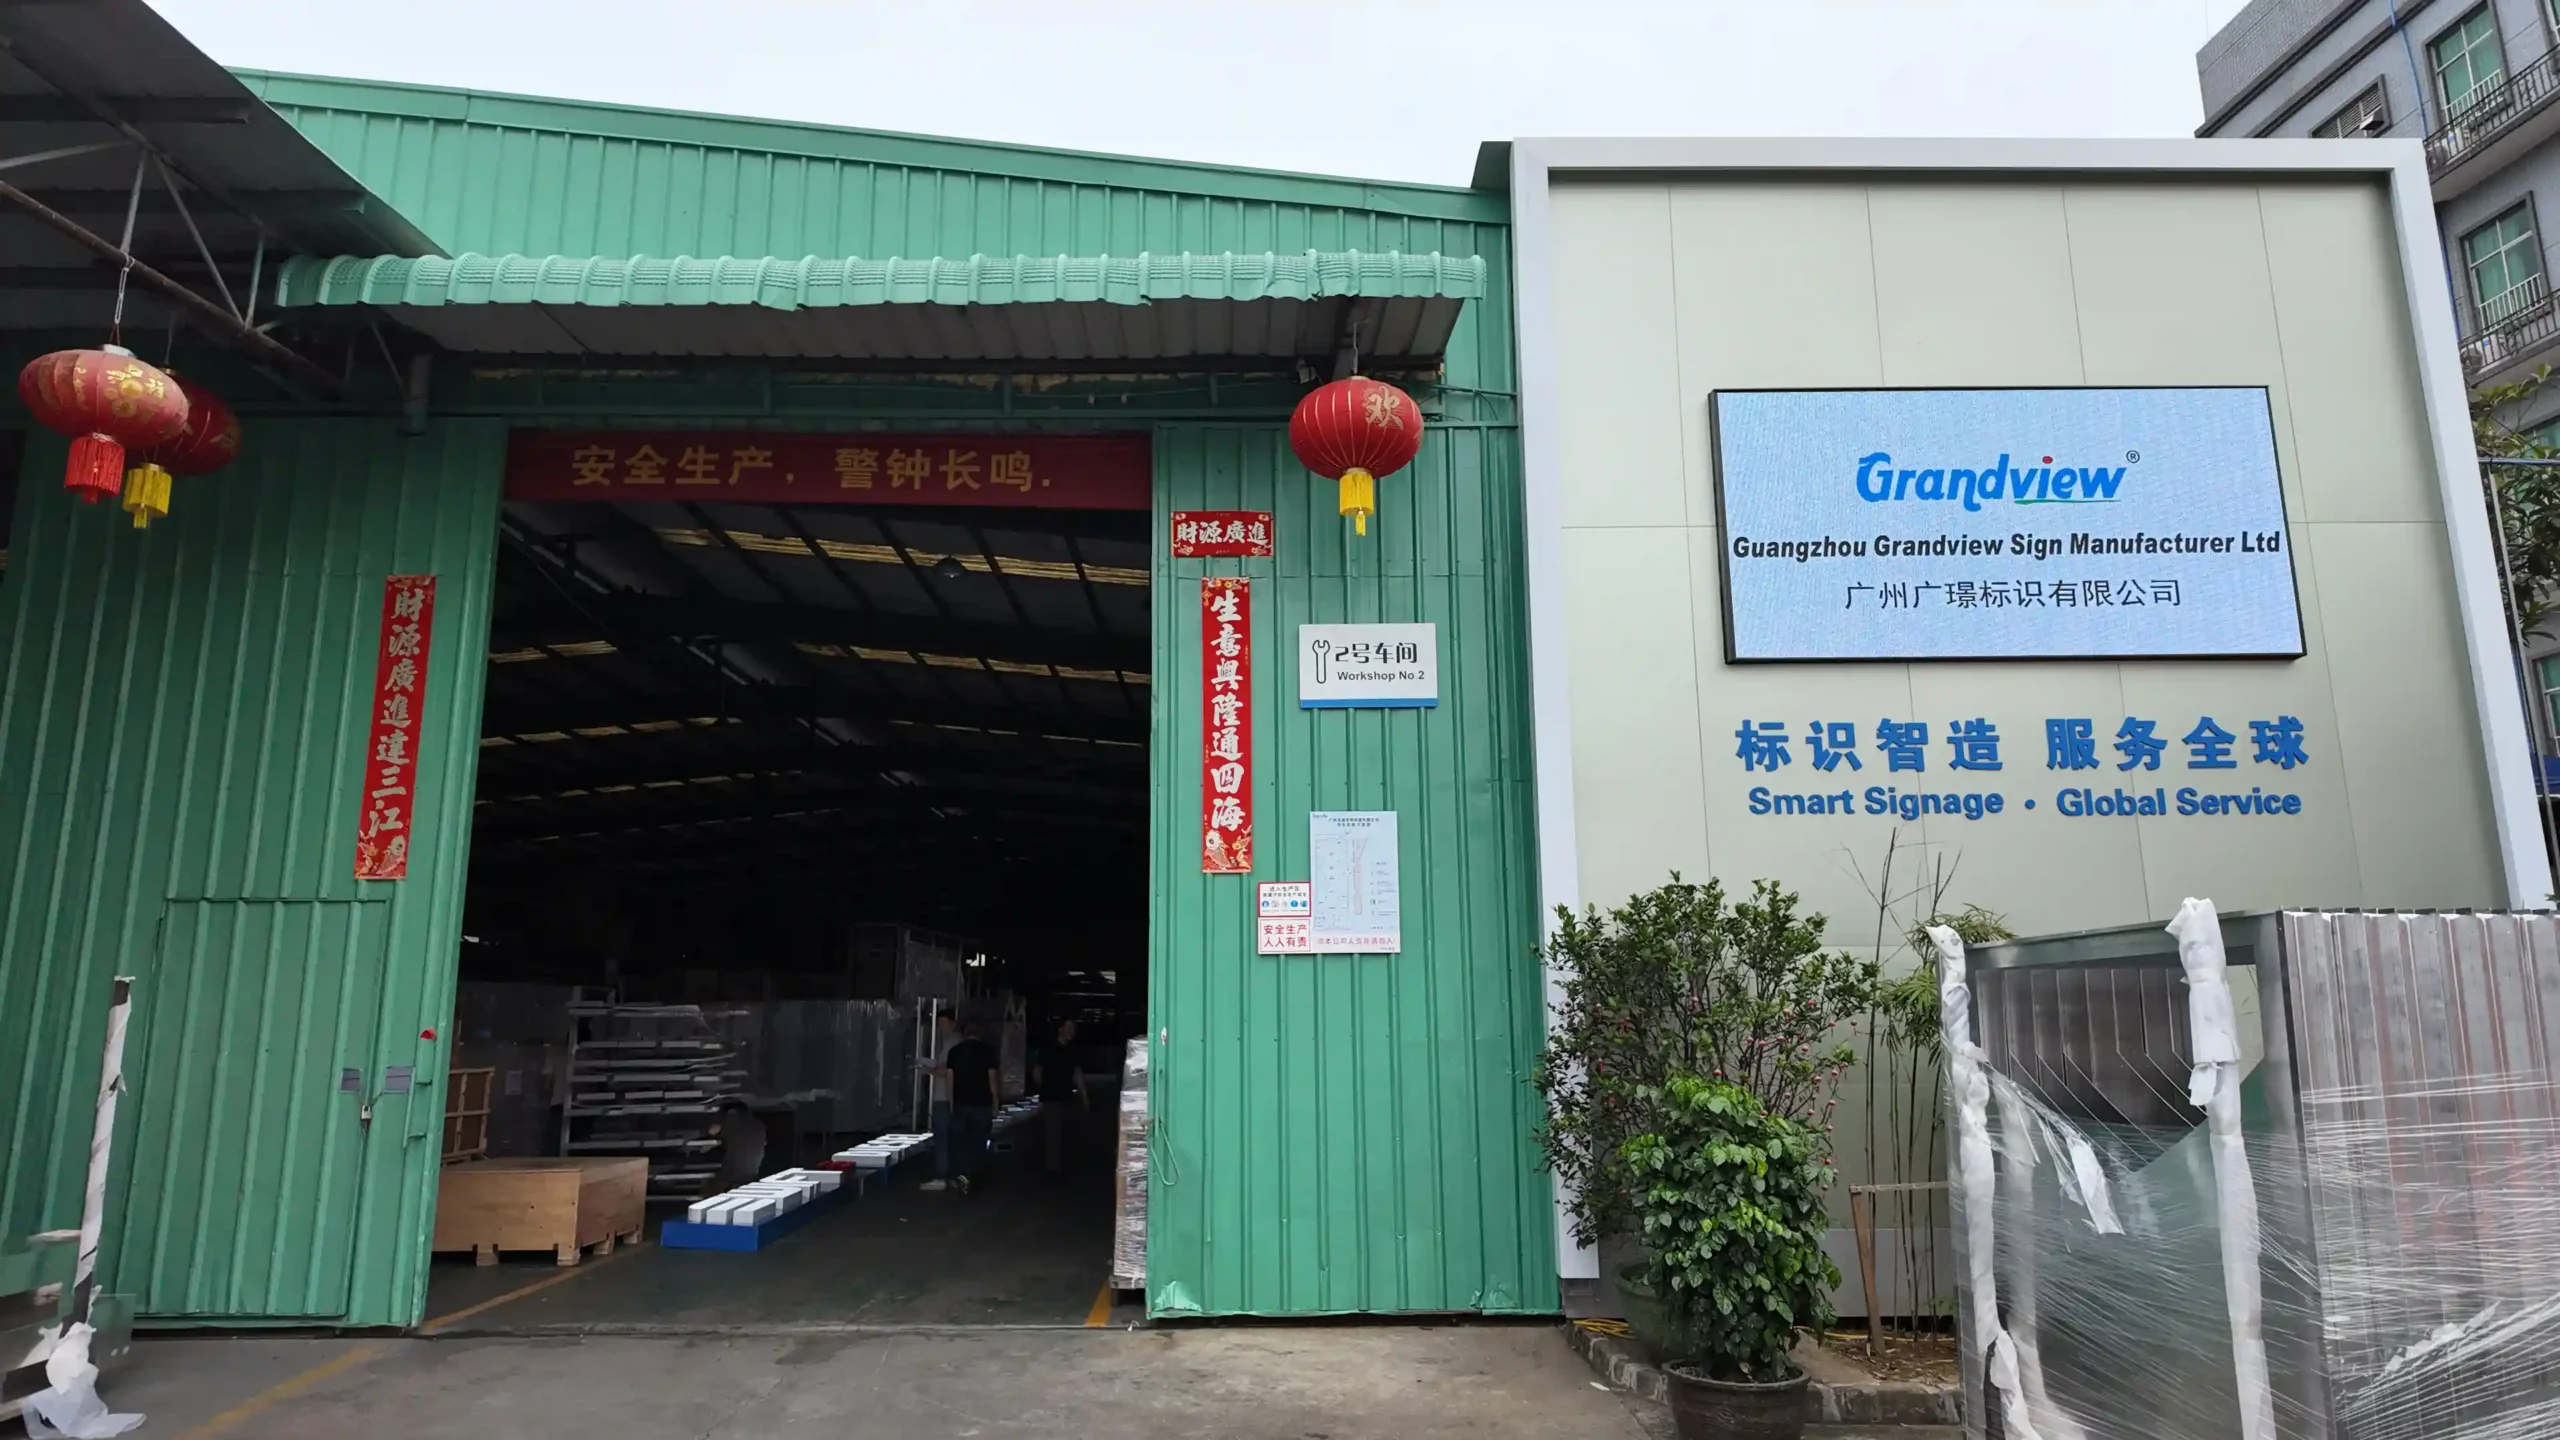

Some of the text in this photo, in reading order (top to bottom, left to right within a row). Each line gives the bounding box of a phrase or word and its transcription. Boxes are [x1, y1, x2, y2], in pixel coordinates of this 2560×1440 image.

[1174, 519, 1269, 546] 財源廣進
[1732, 531, 2281, 563] Guangzhou Grandview Sign Manufacturer Ltd
[1845, 578, 2182, 610] 广州广璟标识有限公司
[1335, 642, 1418, 664] 2号车间
[1337, 670, 1396, 682] Workshop
[1209, 589, 1247, 832] 生意興隆通四海
[1735, 715, 2310, 773] 标识智造 服务全球
[1749, 786, 2303, 820] Smart Signage Global Service
[1263, 924, 1308, 935] 安全生产
[1263, 936, 1308, 948] 人人有责
